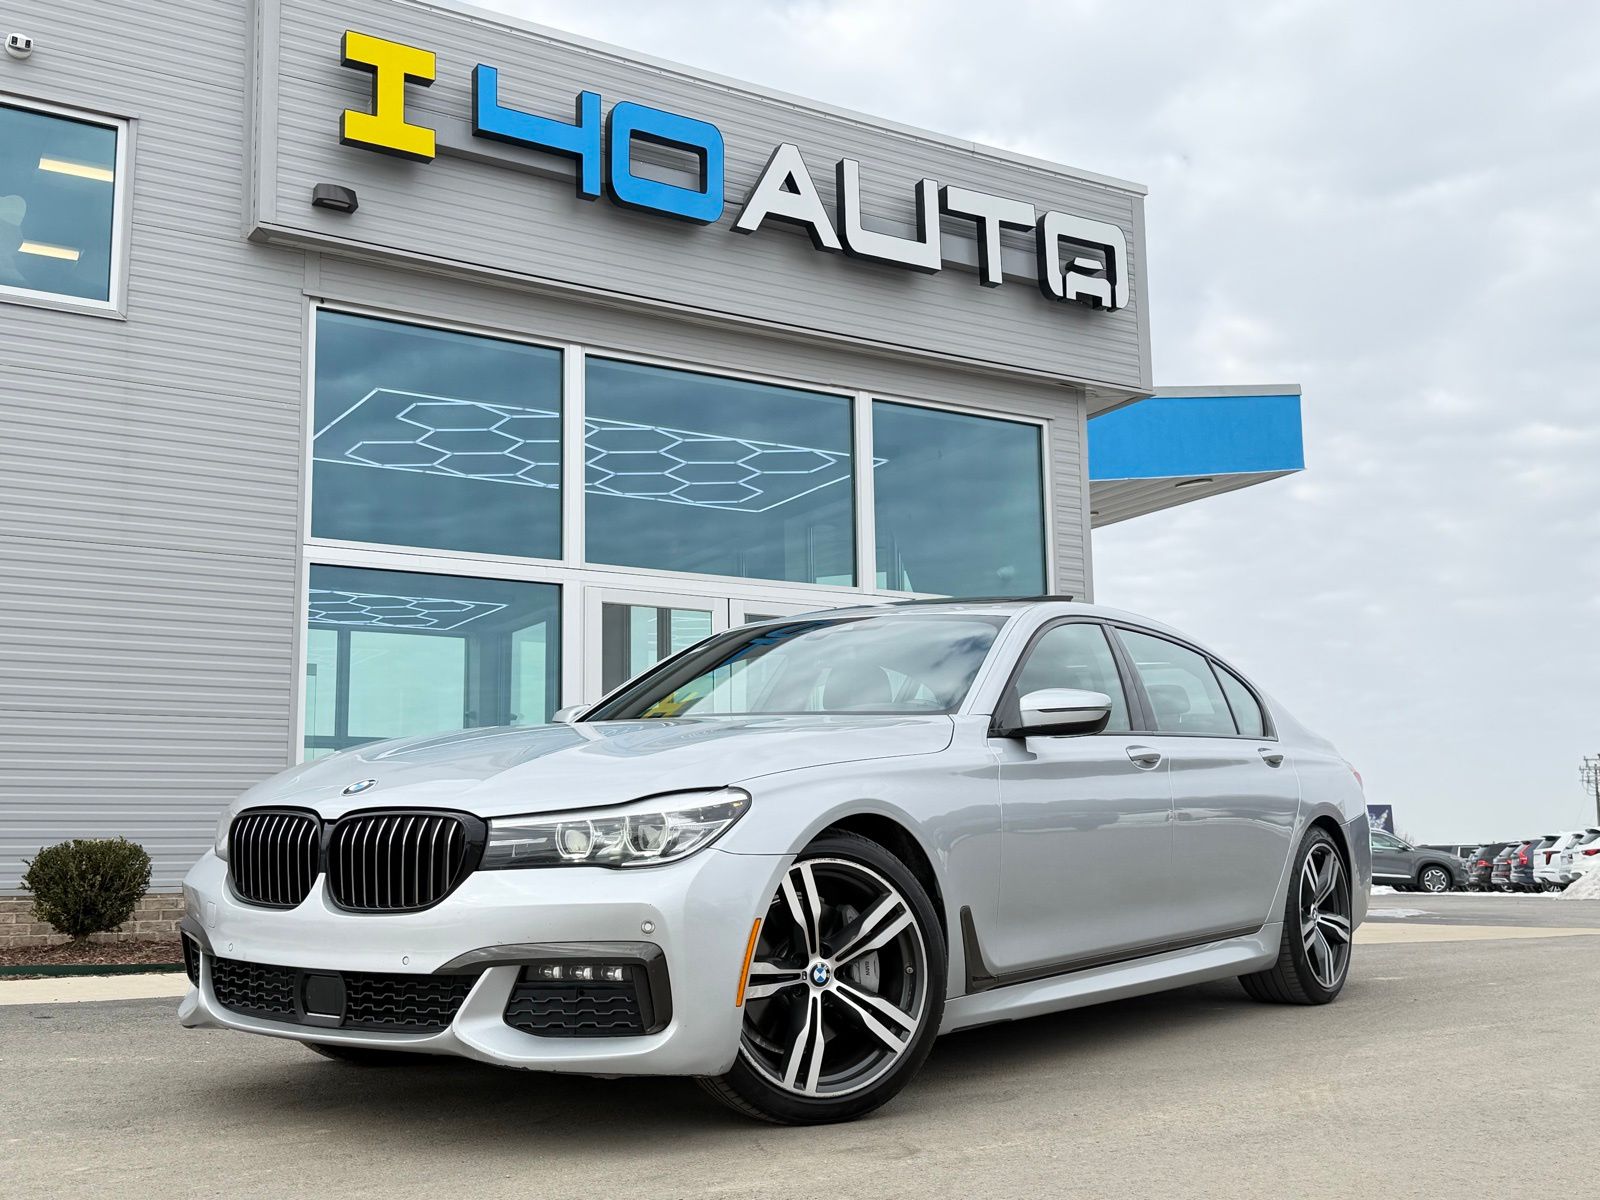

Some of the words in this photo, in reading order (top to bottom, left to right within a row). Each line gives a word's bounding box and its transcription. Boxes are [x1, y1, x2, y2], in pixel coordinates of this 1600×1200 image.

[341, 30, 436, 160] I
[472, 64, 725, 226] 40
[730, 143, 1129, 312] AUTO
